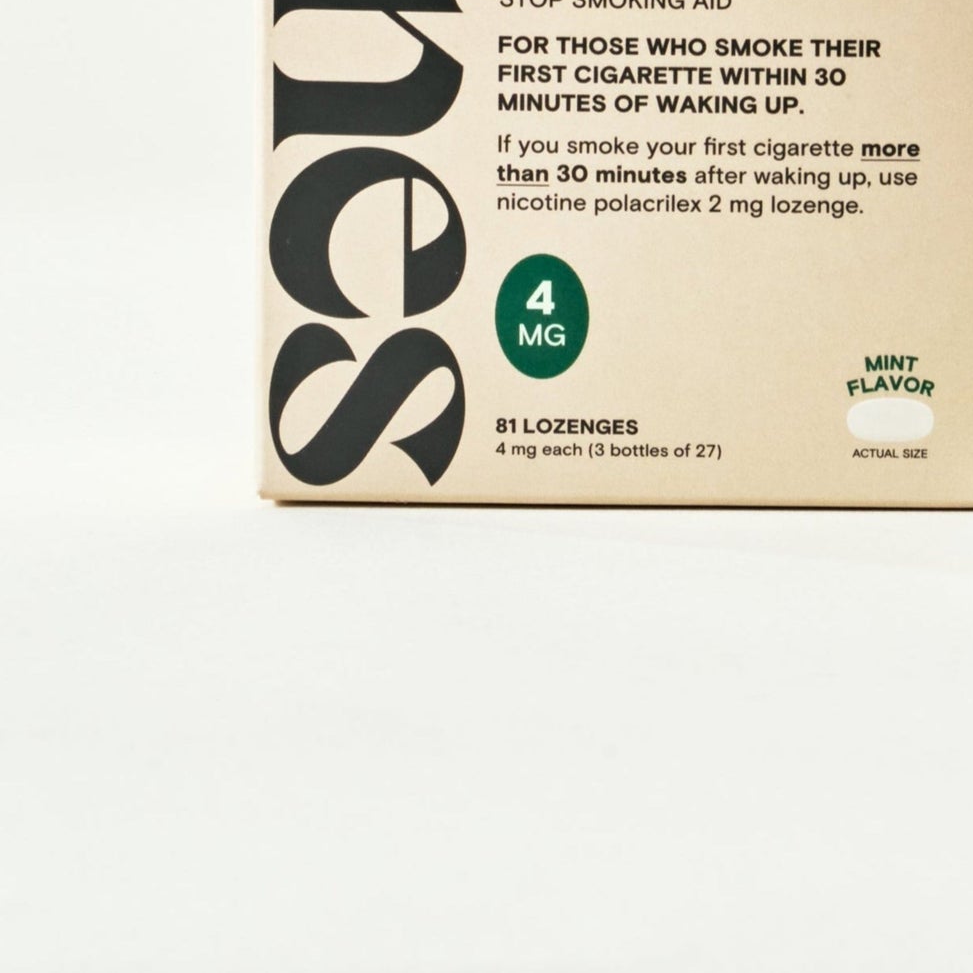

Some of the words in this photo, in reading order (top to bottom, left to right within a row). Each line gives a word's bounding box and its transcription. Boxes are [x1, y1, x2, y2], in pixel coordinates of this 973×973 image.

[499, 36, 548, 54] FOR
[556, 37, 638, 55] THOSE
[647, 38, 706, 56] WHO
[715, 38, 802, 57] SMOKE
[810, 39, 880, 57] THEIR
[499, 65, 567, 83] FIRST
[575, 66, 712, 84] CIGARETTE
[720, 67, 806, 85] WITHIN
[815, 68, 846, 86] 30
[498, 93, 606, 112] MINUTES
[615, 95, 648, 112] OF
[656, 95, 757, 114] WAKING
[766, 96, 804, 114] UP.
[499, 134, 511, 152] If
[519, 140, 558, 157] you
[568, 137, 639, 154] smoke
[647, 142, 696, 159] your
[704, 137, 746, 156] first
[754, 139, 853, 161] cigarette
[861, 144, 920, 161] more
[497, 164, 548, 186] than
[557, 165, 588, 182] 30
[596, 165, 687, 183] minutes
[695, 165, 747, 184] after
[754, 167, 830, 190] waking
[839, 172, 871, 190] up,
[880, 172, 917, 185] use
[498, 193, 586, 211] nicotine
[595, 194, 701, 215] polacrilex
[709, 195, 721, 212] 2
[730, 200, 763, 218] mg
[772, 196, 863, 218] lozenge.
[525, 280, 555, 315] 4
[518, 323, 566, 347] MG
[864, 354, 919, 372] MINT
[846, 375, 935, 397] FLAVOR
[496, 418, 516, 433] 81
[524, 419, 638, 435] LOZENGES
[496, 442, 506, 455] 4
[512, 445, 536, 459] mg
[542, 443, 582, 456] each
[589, 443, 604, 458] (3
[611, 443, 668, 457] bottles
[674, 443, 691, 457] of
[696, 444, 721, 460] 27)
[852, 448, 899, 458] ACTUAL
[903, 449, 927, 458] SIZE
